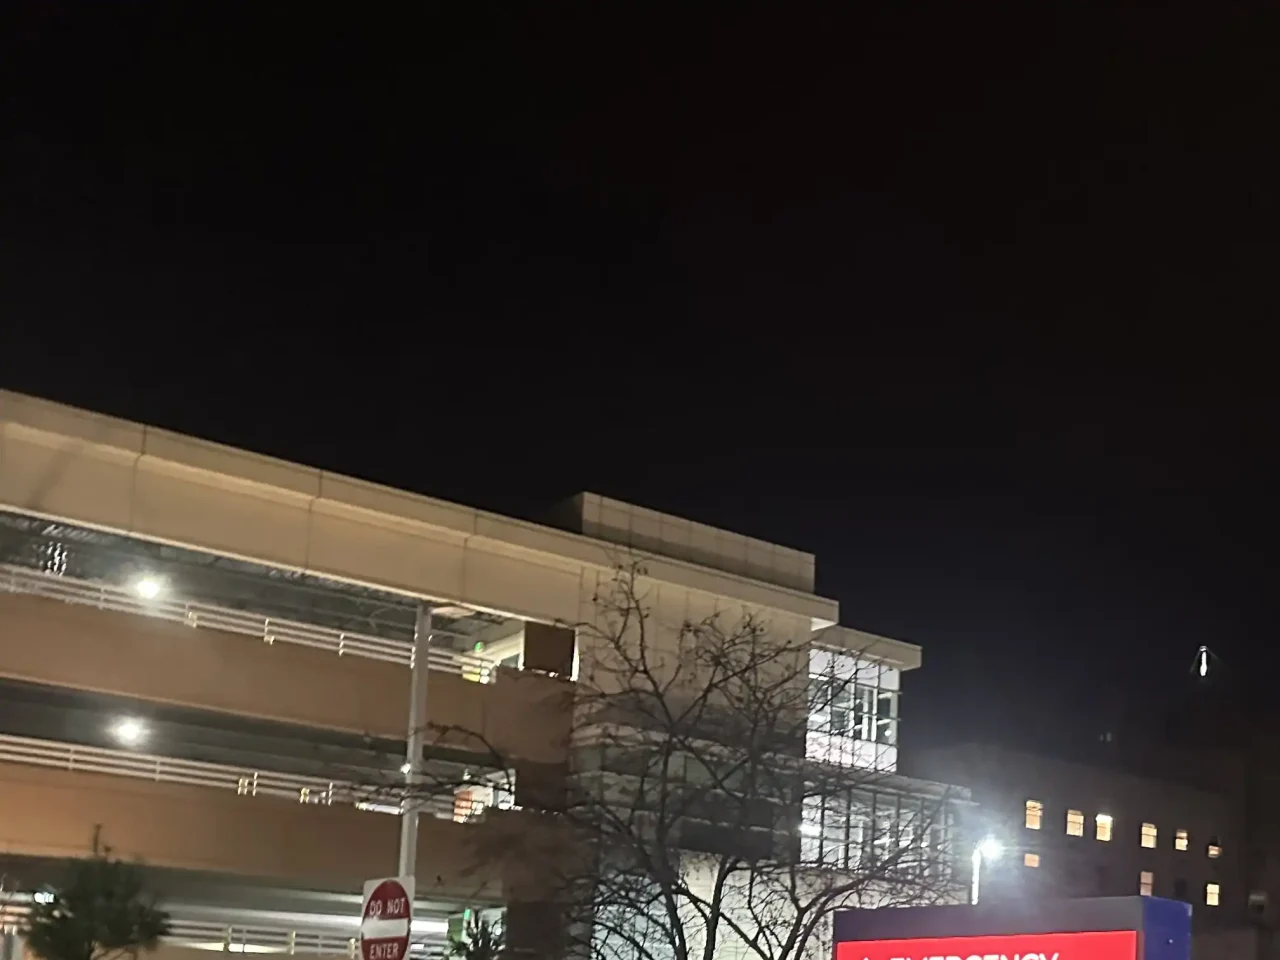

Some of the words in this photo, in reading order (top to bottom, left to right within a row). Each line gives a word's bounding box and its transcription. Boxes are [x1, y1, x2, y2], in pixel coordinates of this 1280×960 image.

[369, 900, 382, 916] DO
[387, 898, 406, 914] NOT
[369, 943, 399, 960] ENTER
